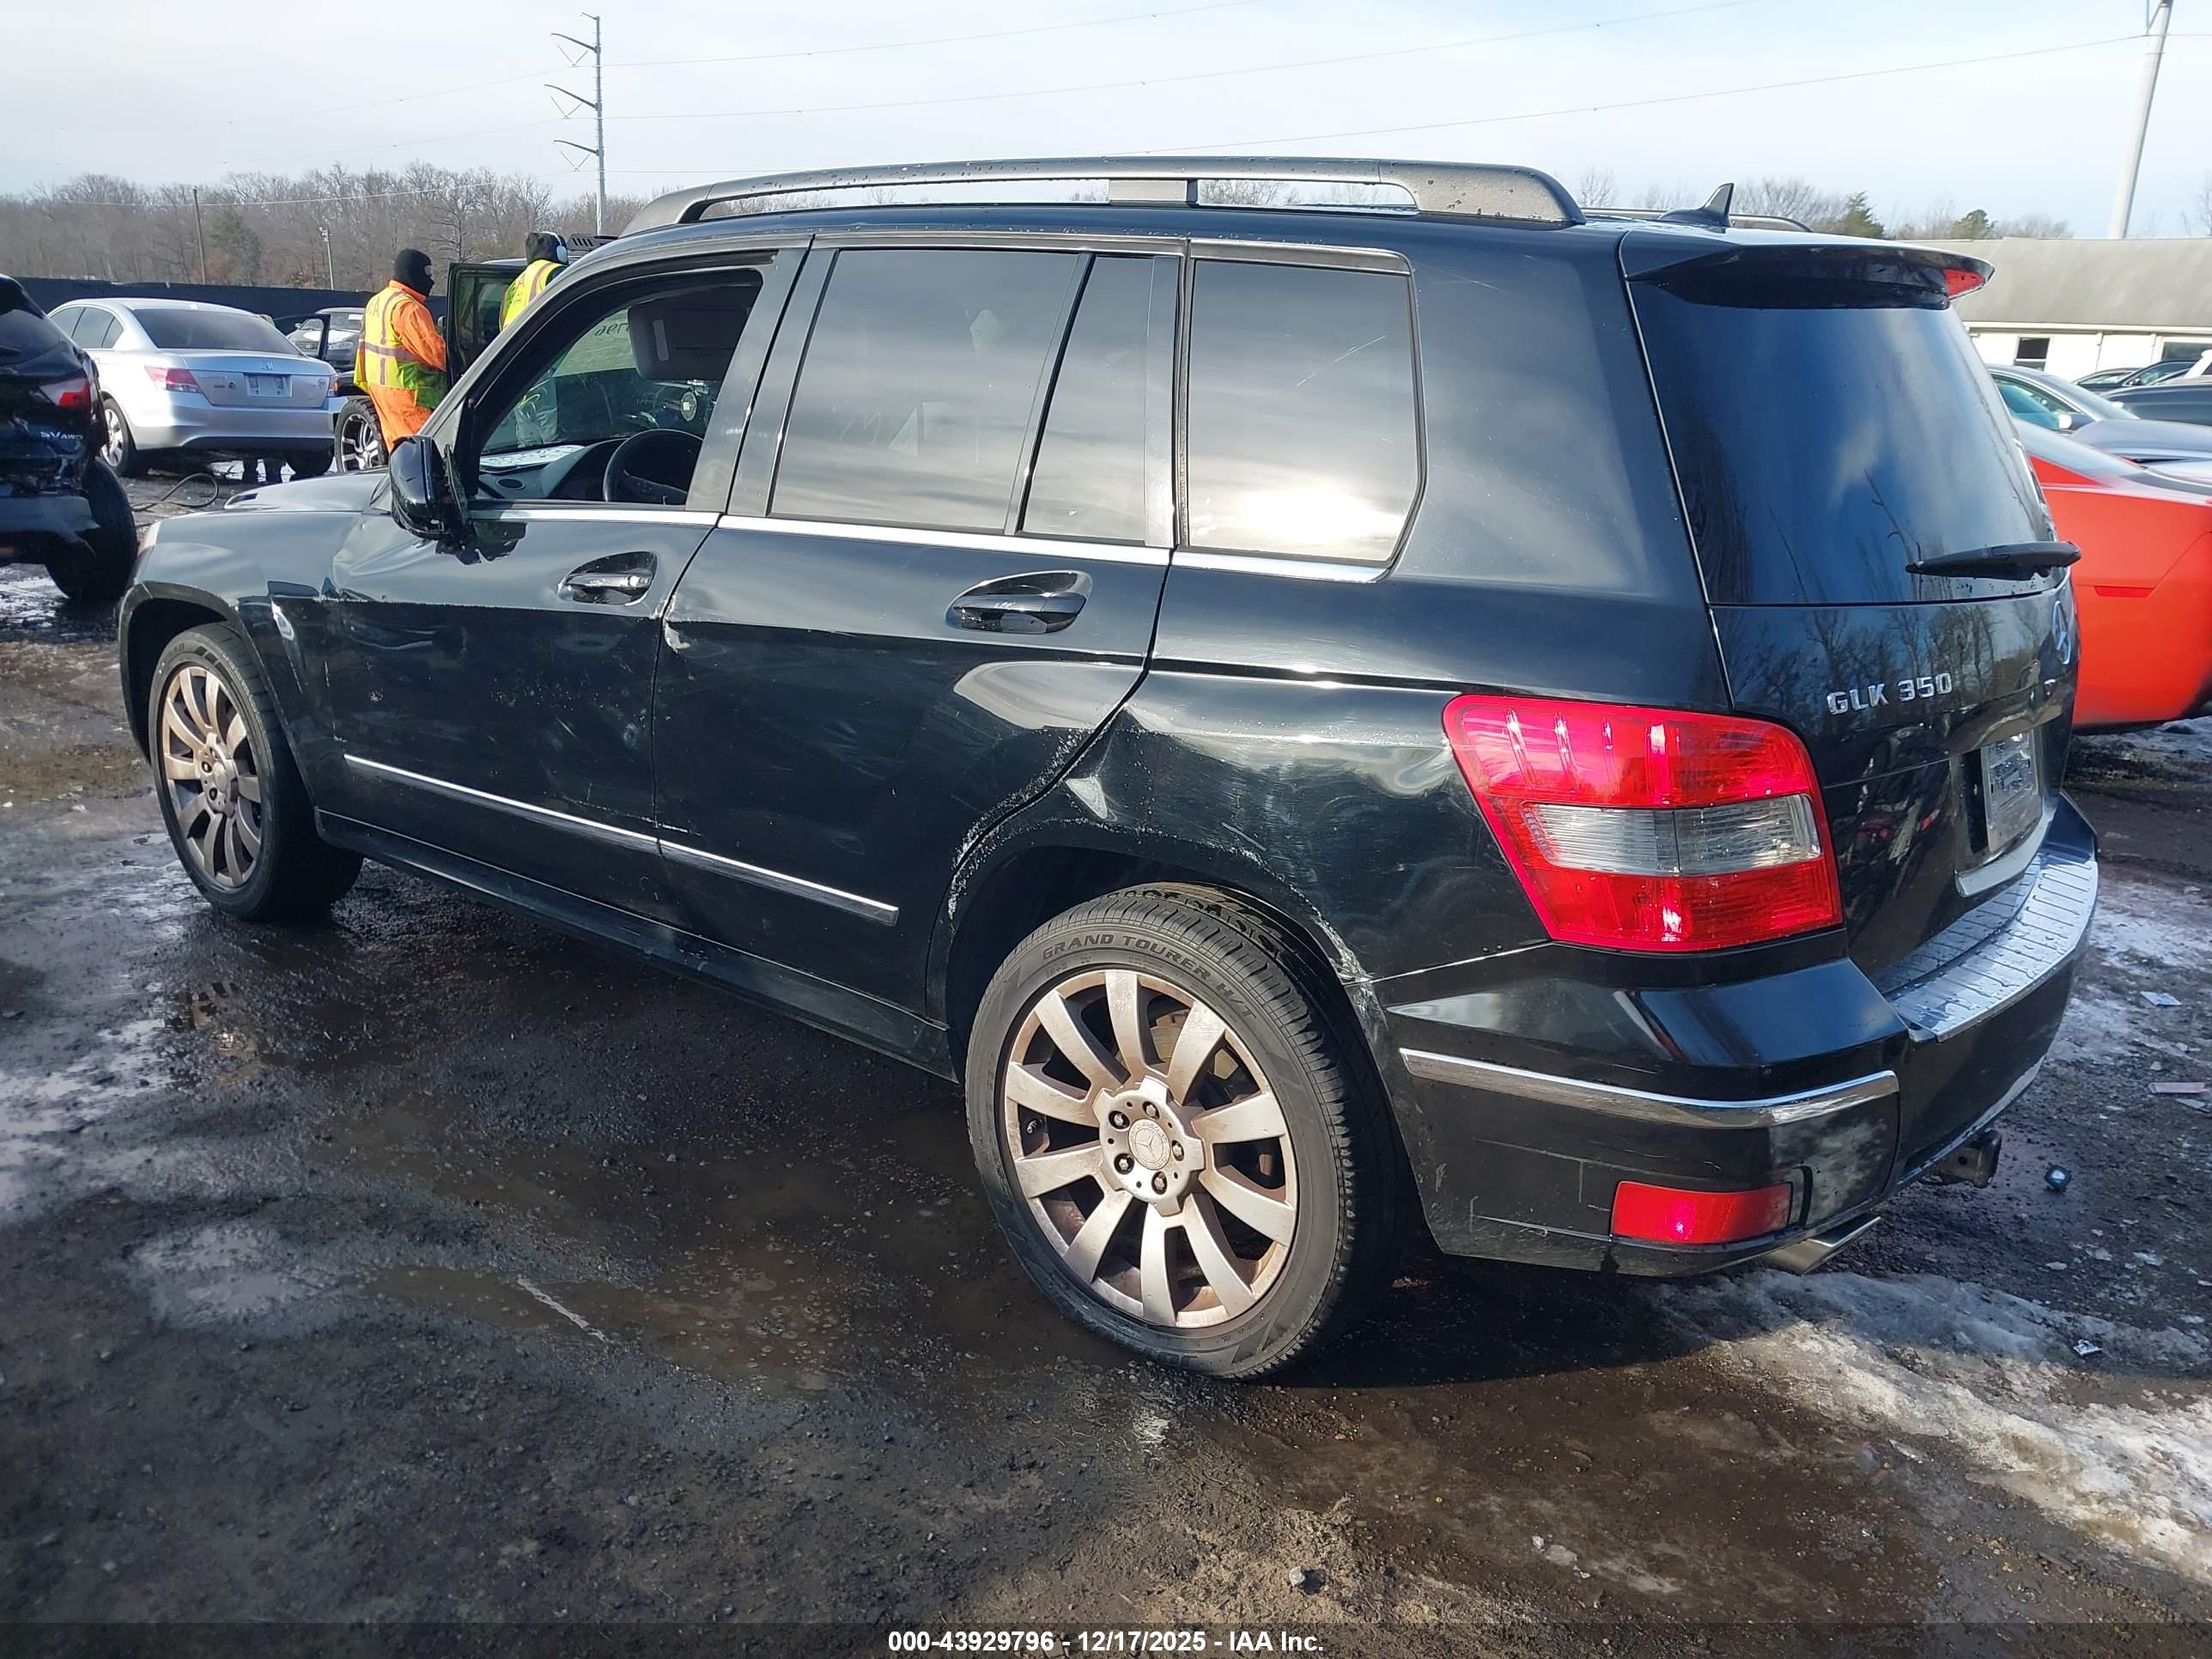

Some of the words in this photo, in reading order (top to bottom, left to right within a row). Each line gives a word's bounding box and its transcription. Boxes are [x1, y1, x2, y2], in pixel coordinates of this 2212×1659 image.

[1826, 684, 1890, 716] GLK
[1897, 672, 1954, 702] 350
[1042, 933, 1115, 962] GRAND
[1123, 935, 1212, 981] TOURER
[1216, 982, 1258, 1021] H/T
